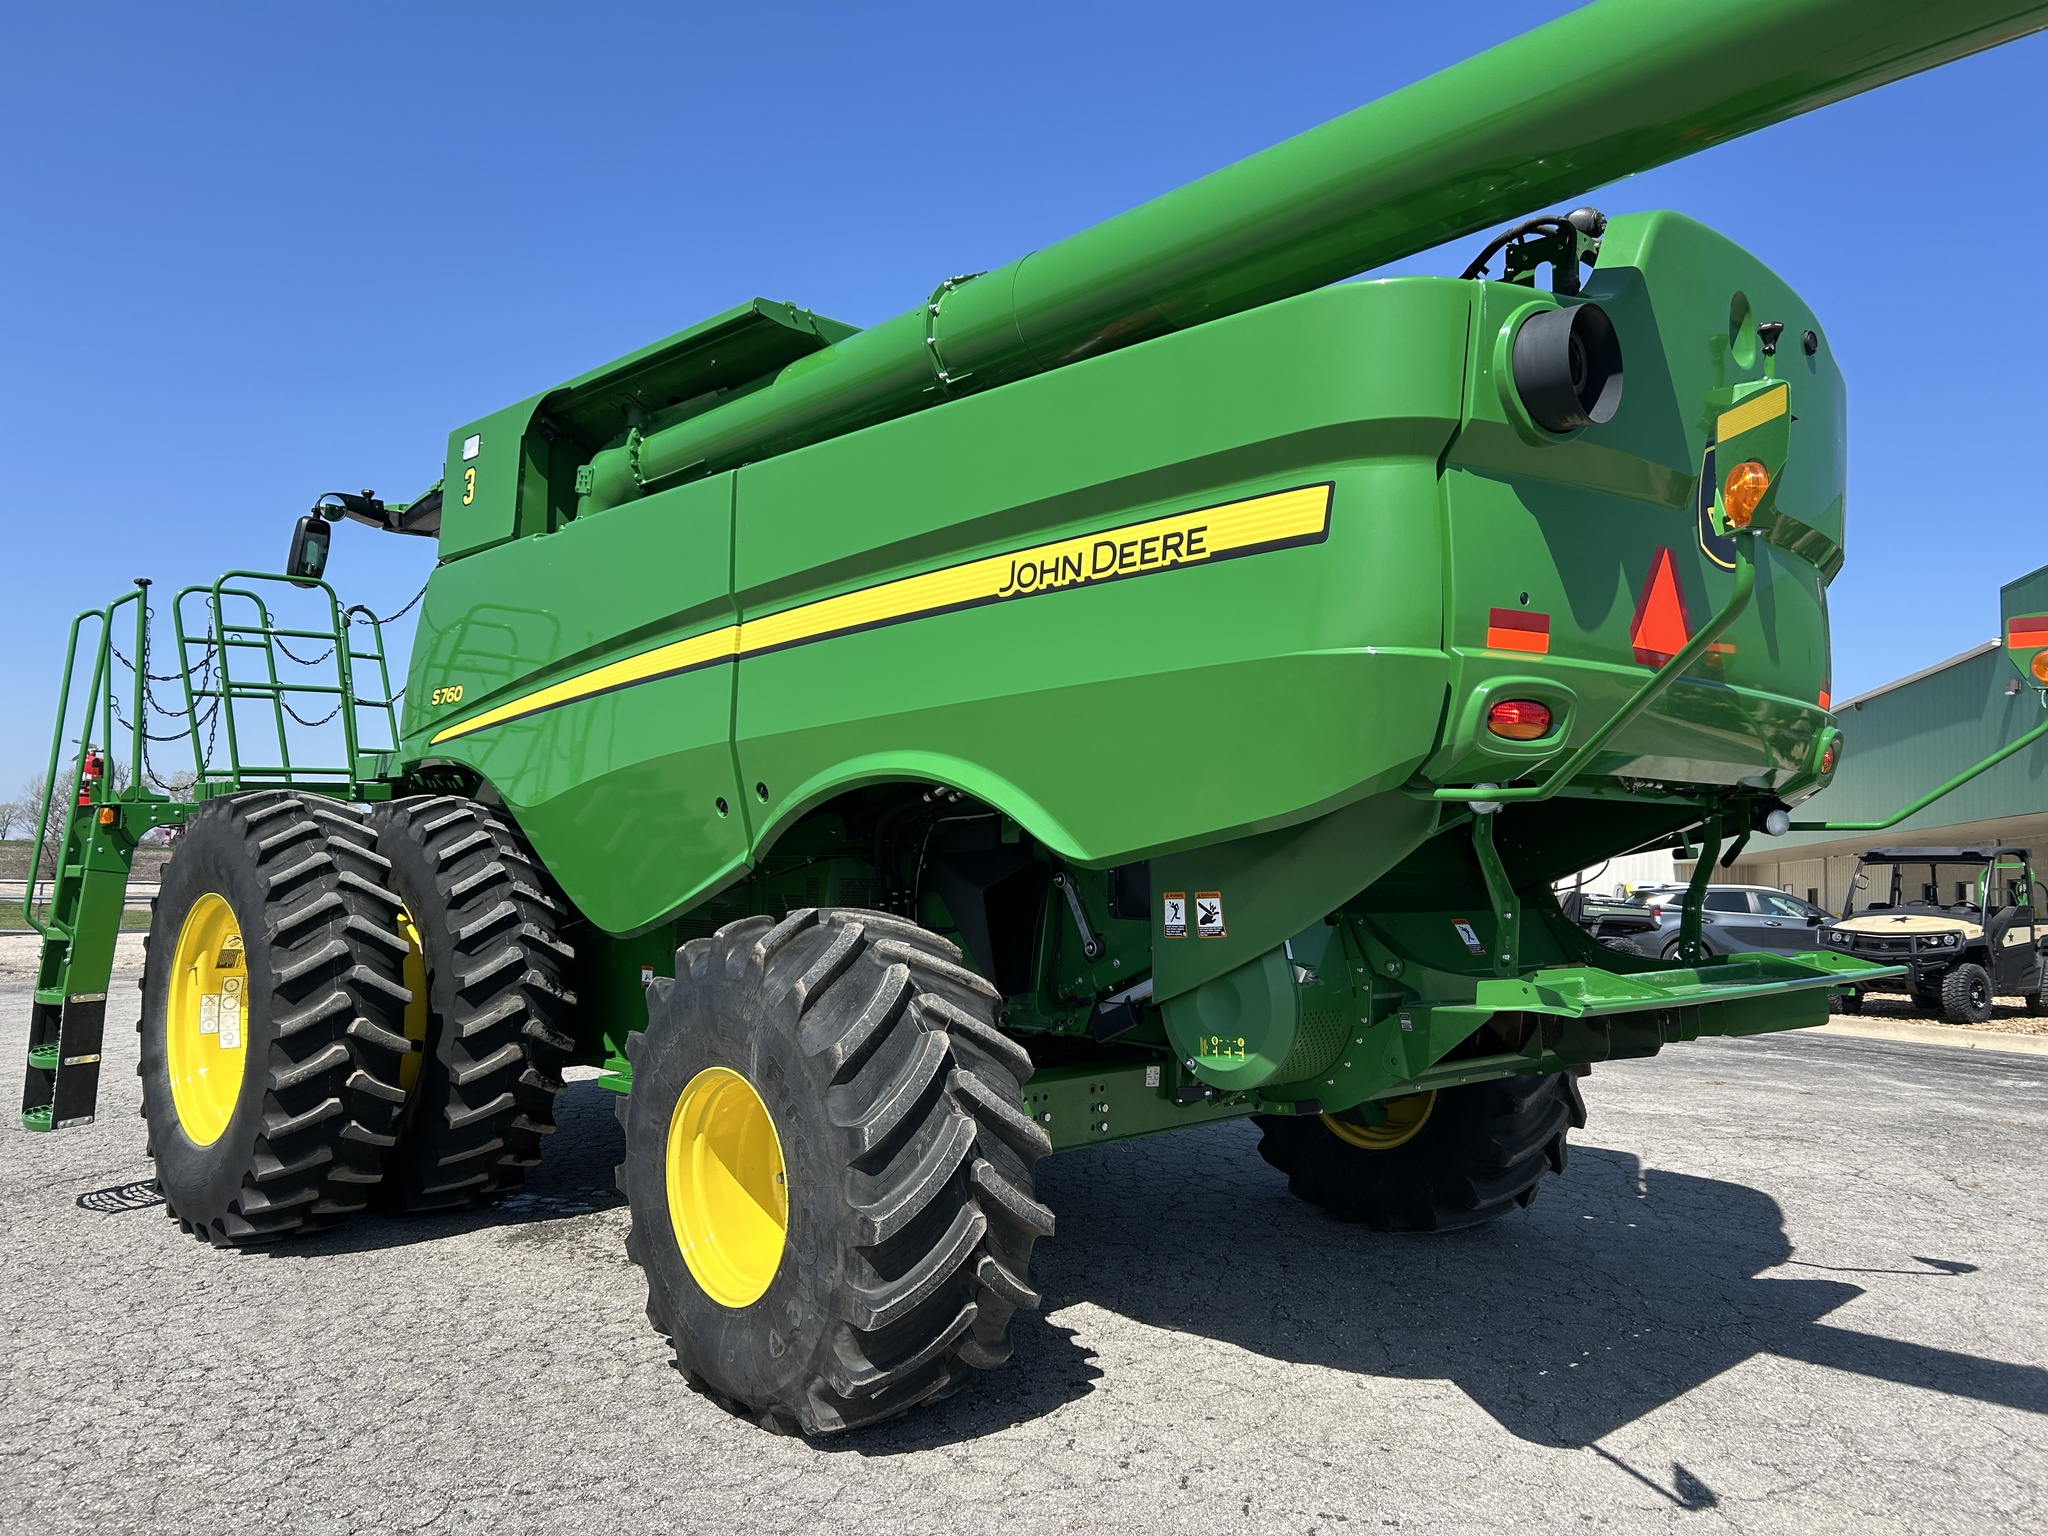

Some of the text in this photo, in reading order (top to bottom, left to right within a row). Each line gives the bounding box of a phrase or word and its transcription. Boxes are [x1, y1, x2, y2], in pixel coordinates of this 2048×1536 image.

[462, 466, 476, 506] 3
[999, 525, 1208, 593] JOHN DEERE
[431, 684, 464, 706] S760
